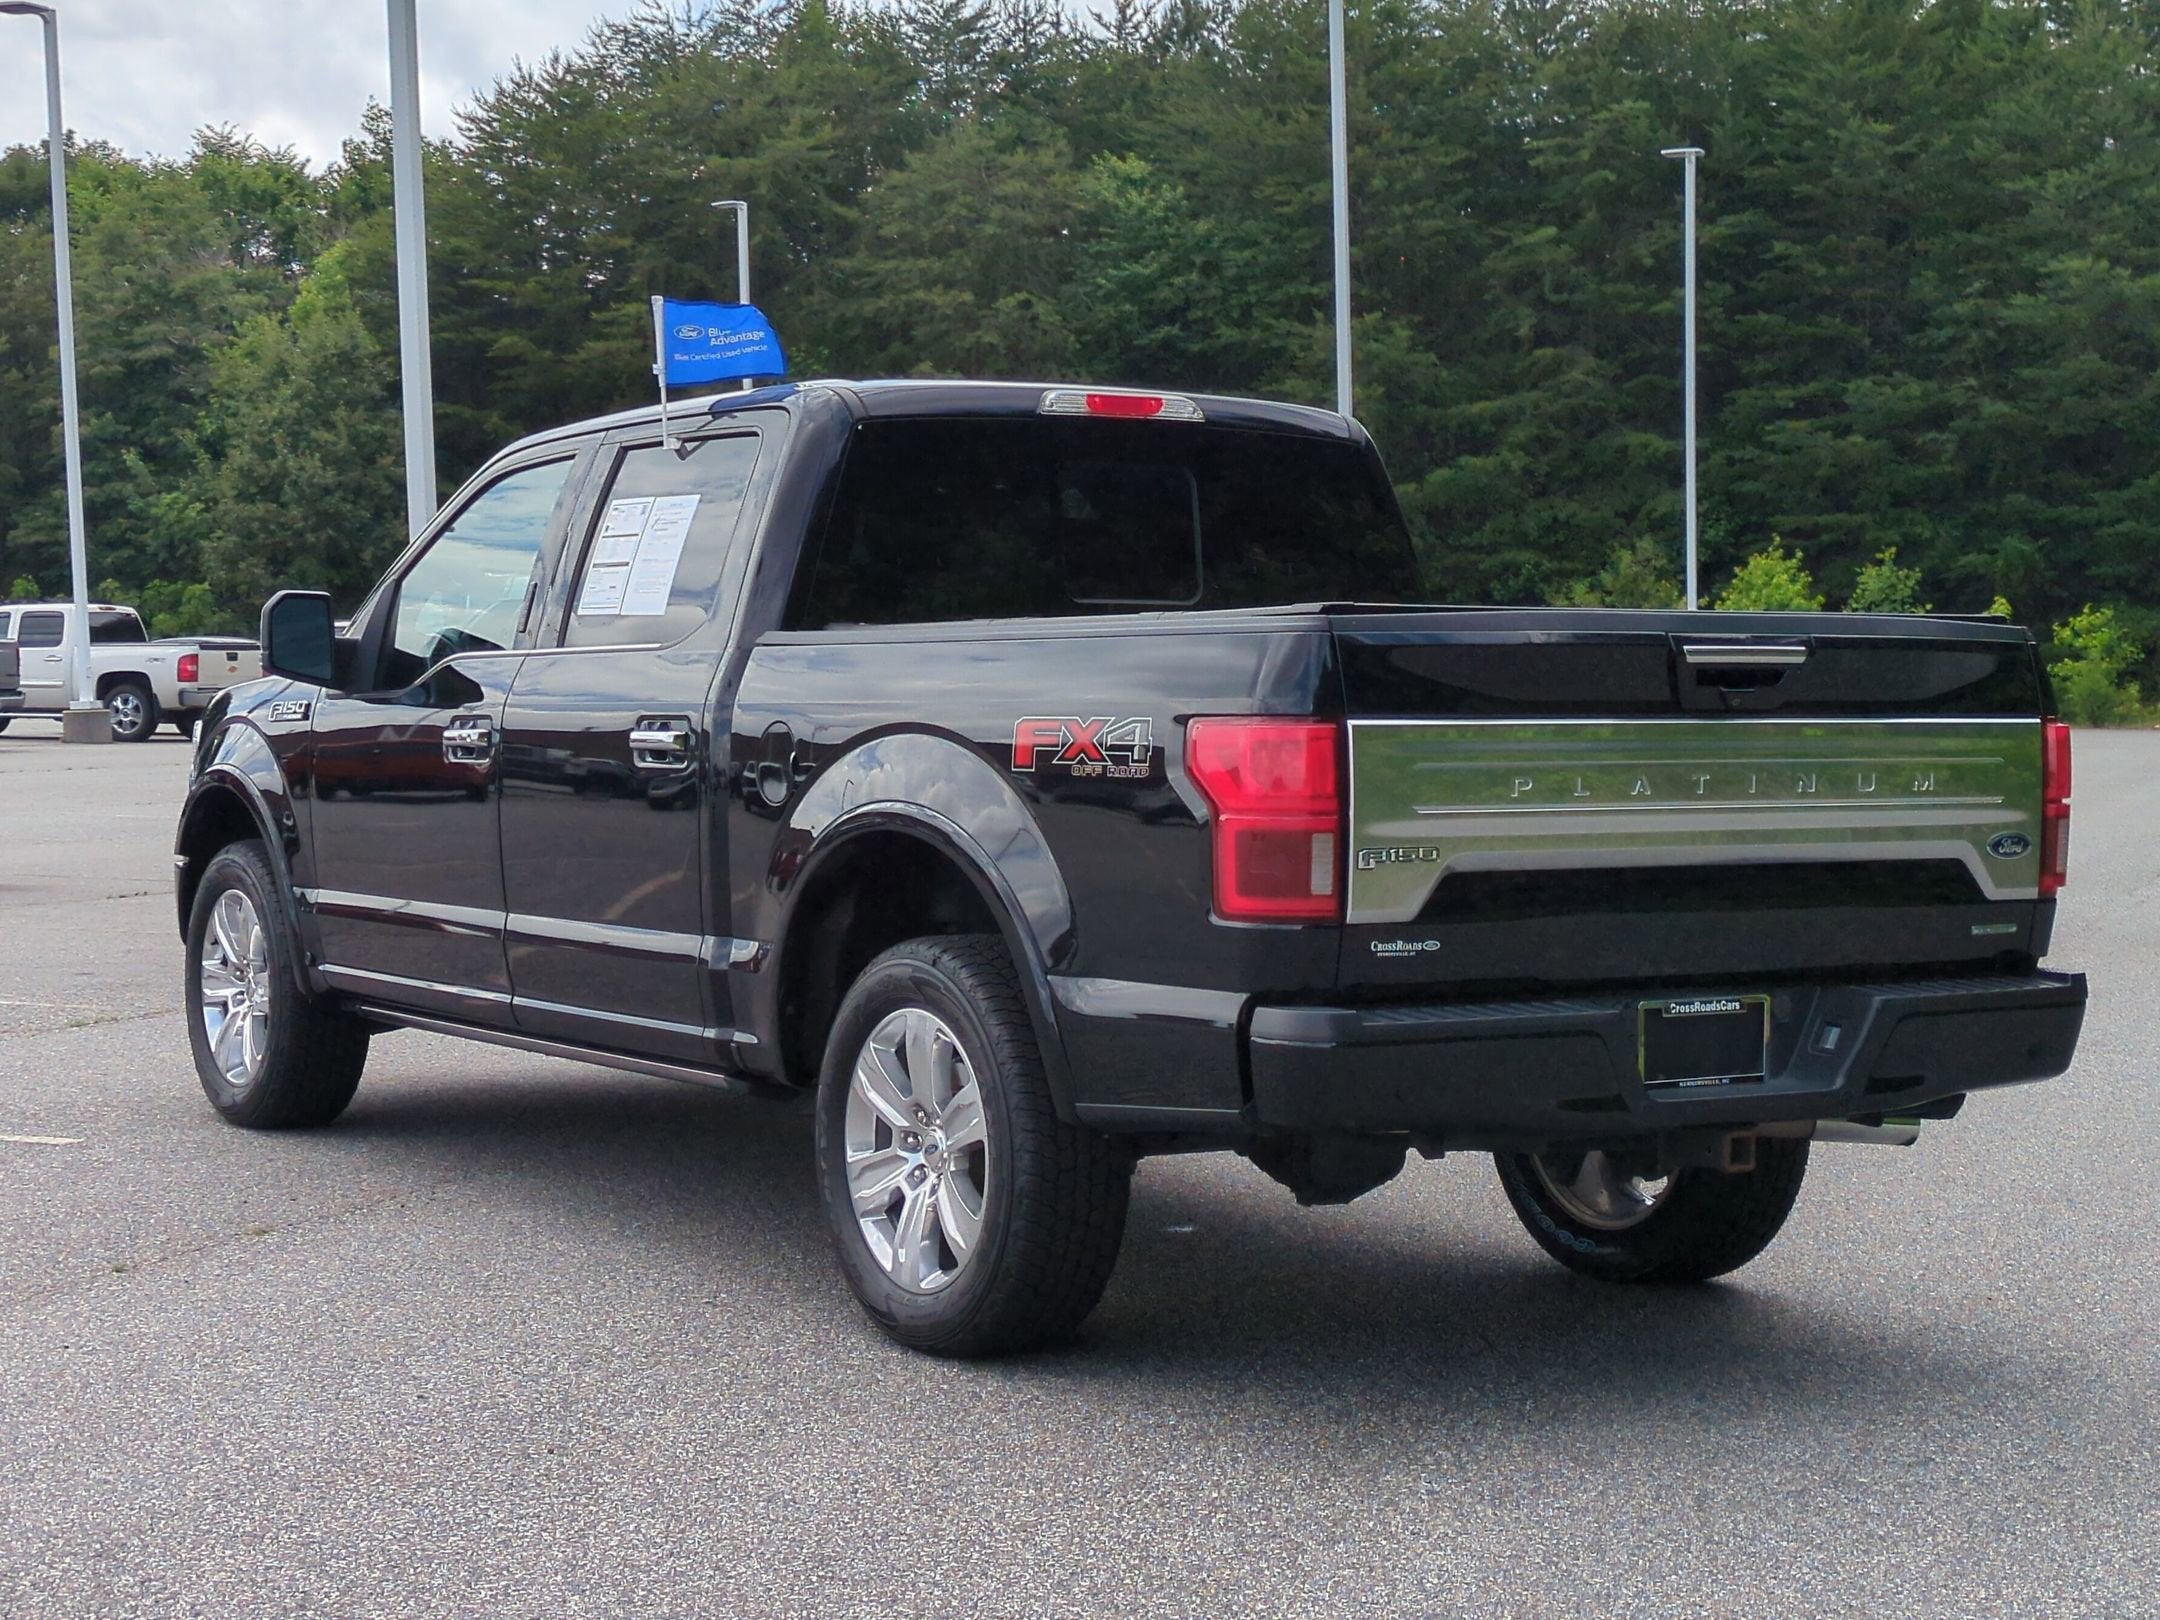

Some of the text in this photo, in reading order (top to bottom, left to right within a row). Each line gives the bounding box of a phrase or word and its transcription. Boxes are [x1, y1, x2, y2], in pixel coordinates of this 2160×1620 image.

[710, 330, 766, 346] Advantage
[721, 350, 742, 359] Used
[742, 344, 769, 354] Vehicle
[1011, 716, 1153, 772] FX4
[1071, 764, 1150, 778] OFF ROAD
[1510, 772, 1936, 798] PLATINUM
[1670, 1000, 1741, 1014] CrossRoadsCars
